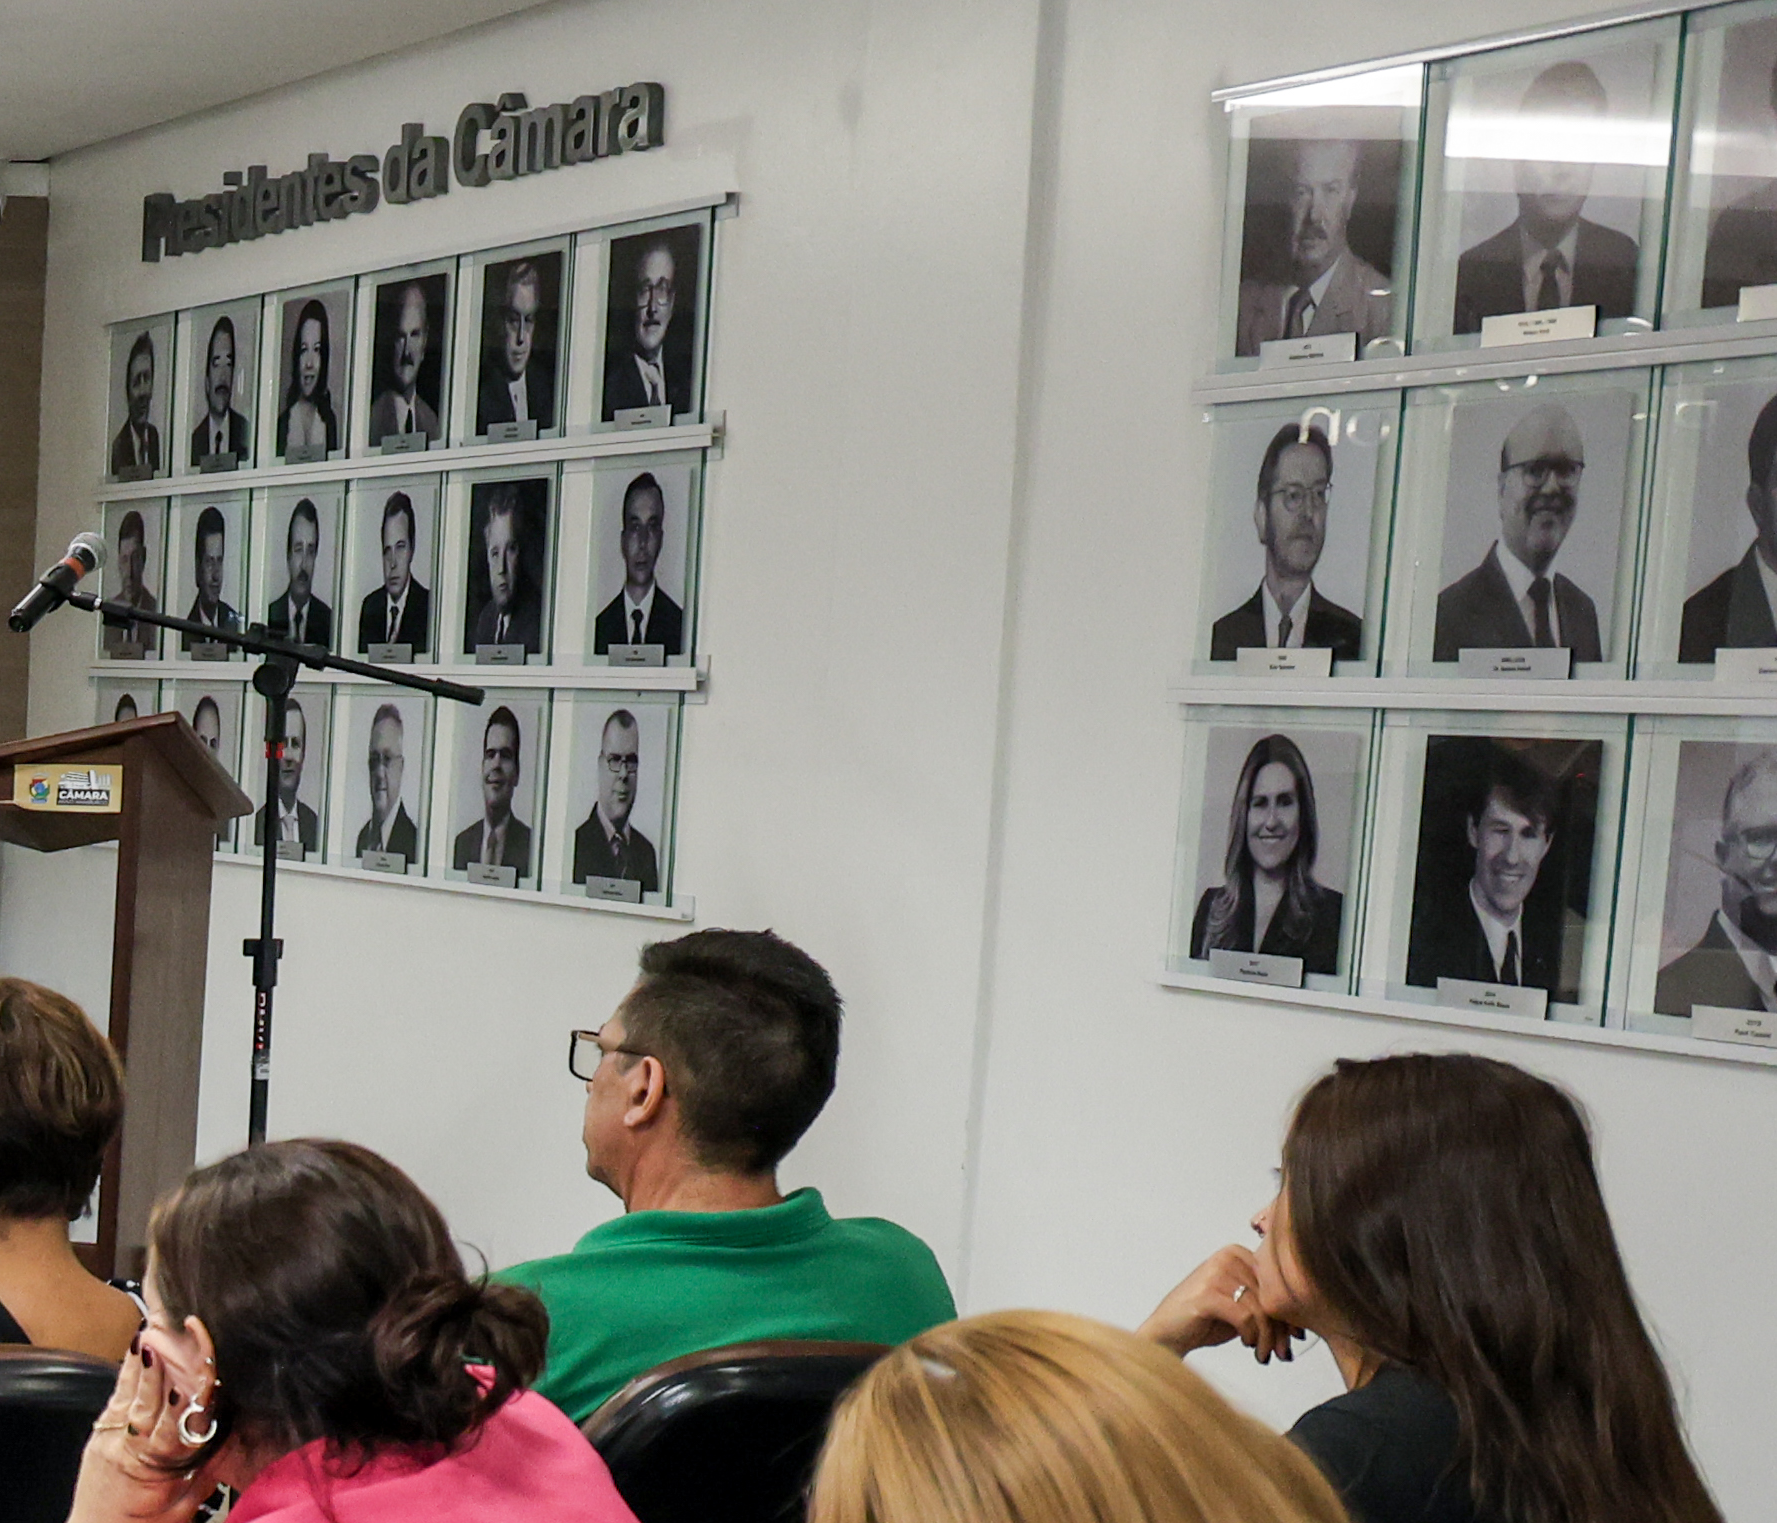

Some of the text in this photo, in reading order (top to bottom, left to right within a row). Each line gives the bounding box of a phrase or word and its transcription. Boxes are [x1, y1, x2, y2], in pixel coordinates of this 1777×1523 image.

[142, 82, 664, 262] Presidentes da Câmara
